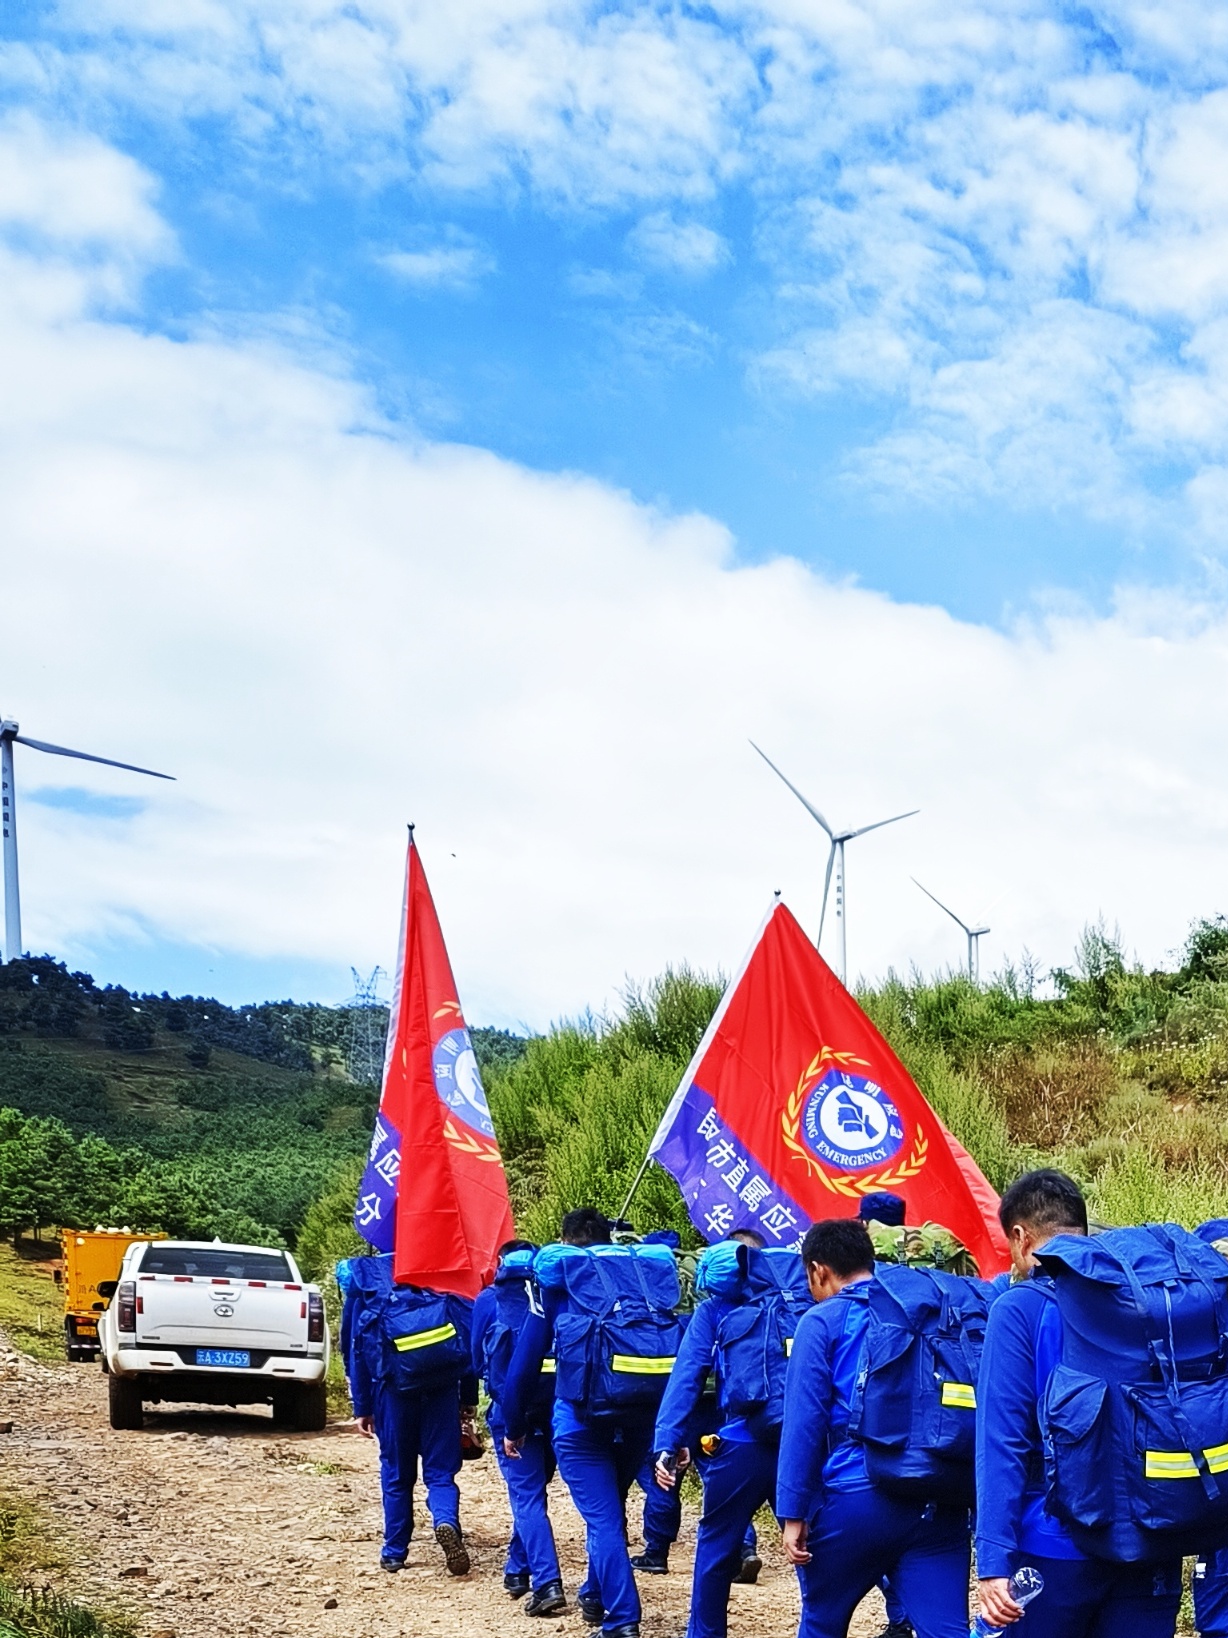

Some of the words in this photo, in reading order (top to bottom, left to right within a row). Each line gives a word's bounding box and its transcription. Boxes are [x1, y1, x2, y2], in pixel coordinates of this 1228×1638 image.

[806, 1083, 829, 1138] KUNMING
[816, 1140, 887, 1167] EMERGENCY
[356, 1192, 381, 1226] 分
